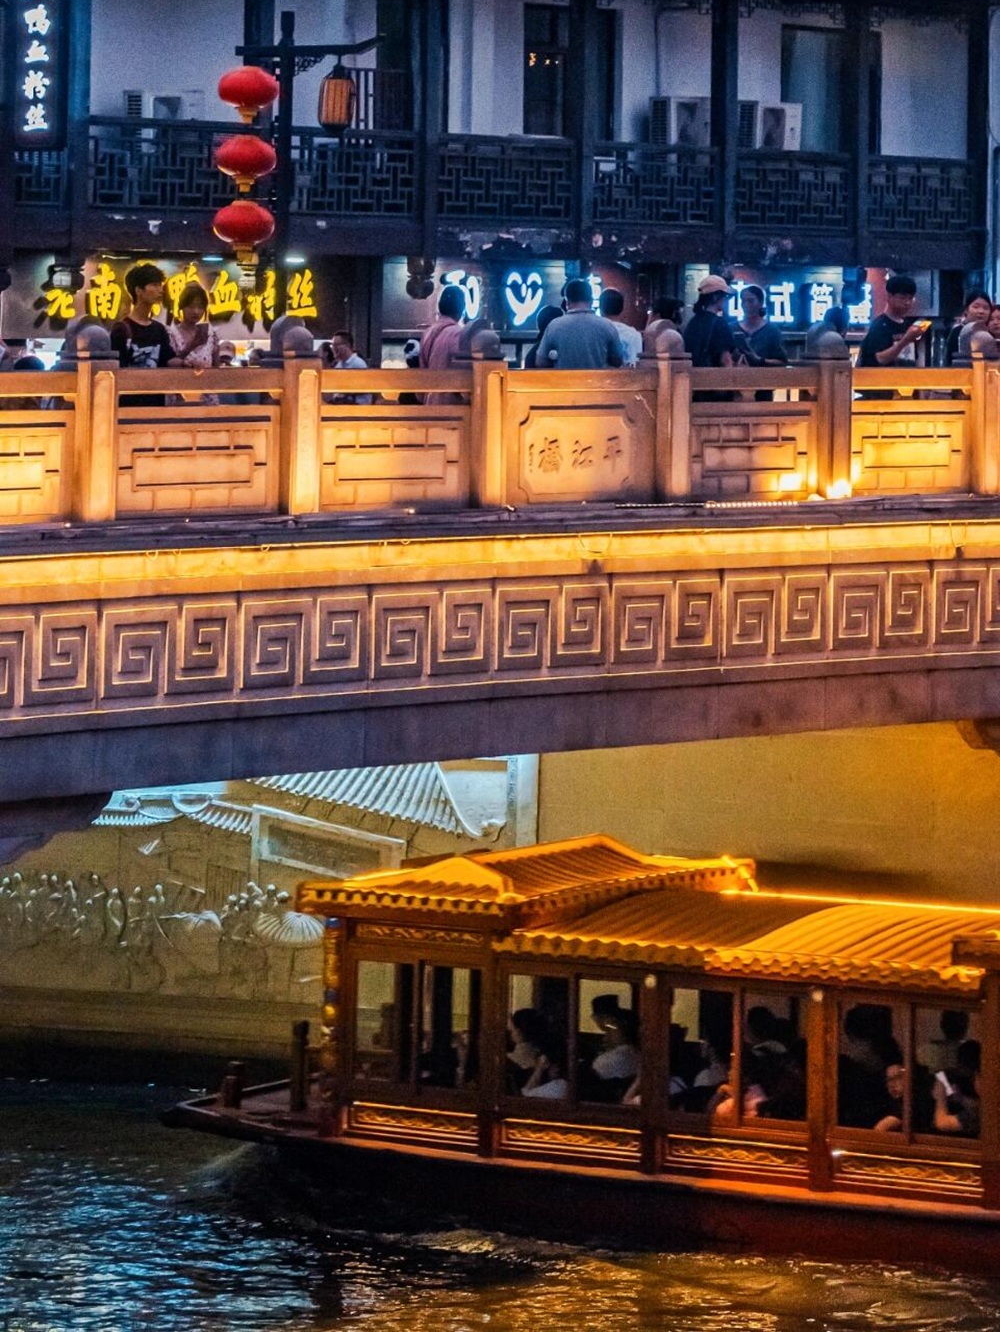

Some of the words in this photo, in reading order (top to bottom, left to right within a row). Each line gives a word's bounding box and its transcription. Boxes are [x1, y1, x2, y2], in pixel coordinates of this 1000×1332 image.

[45, 260, 317, 320] 老南鸭血粉丝
